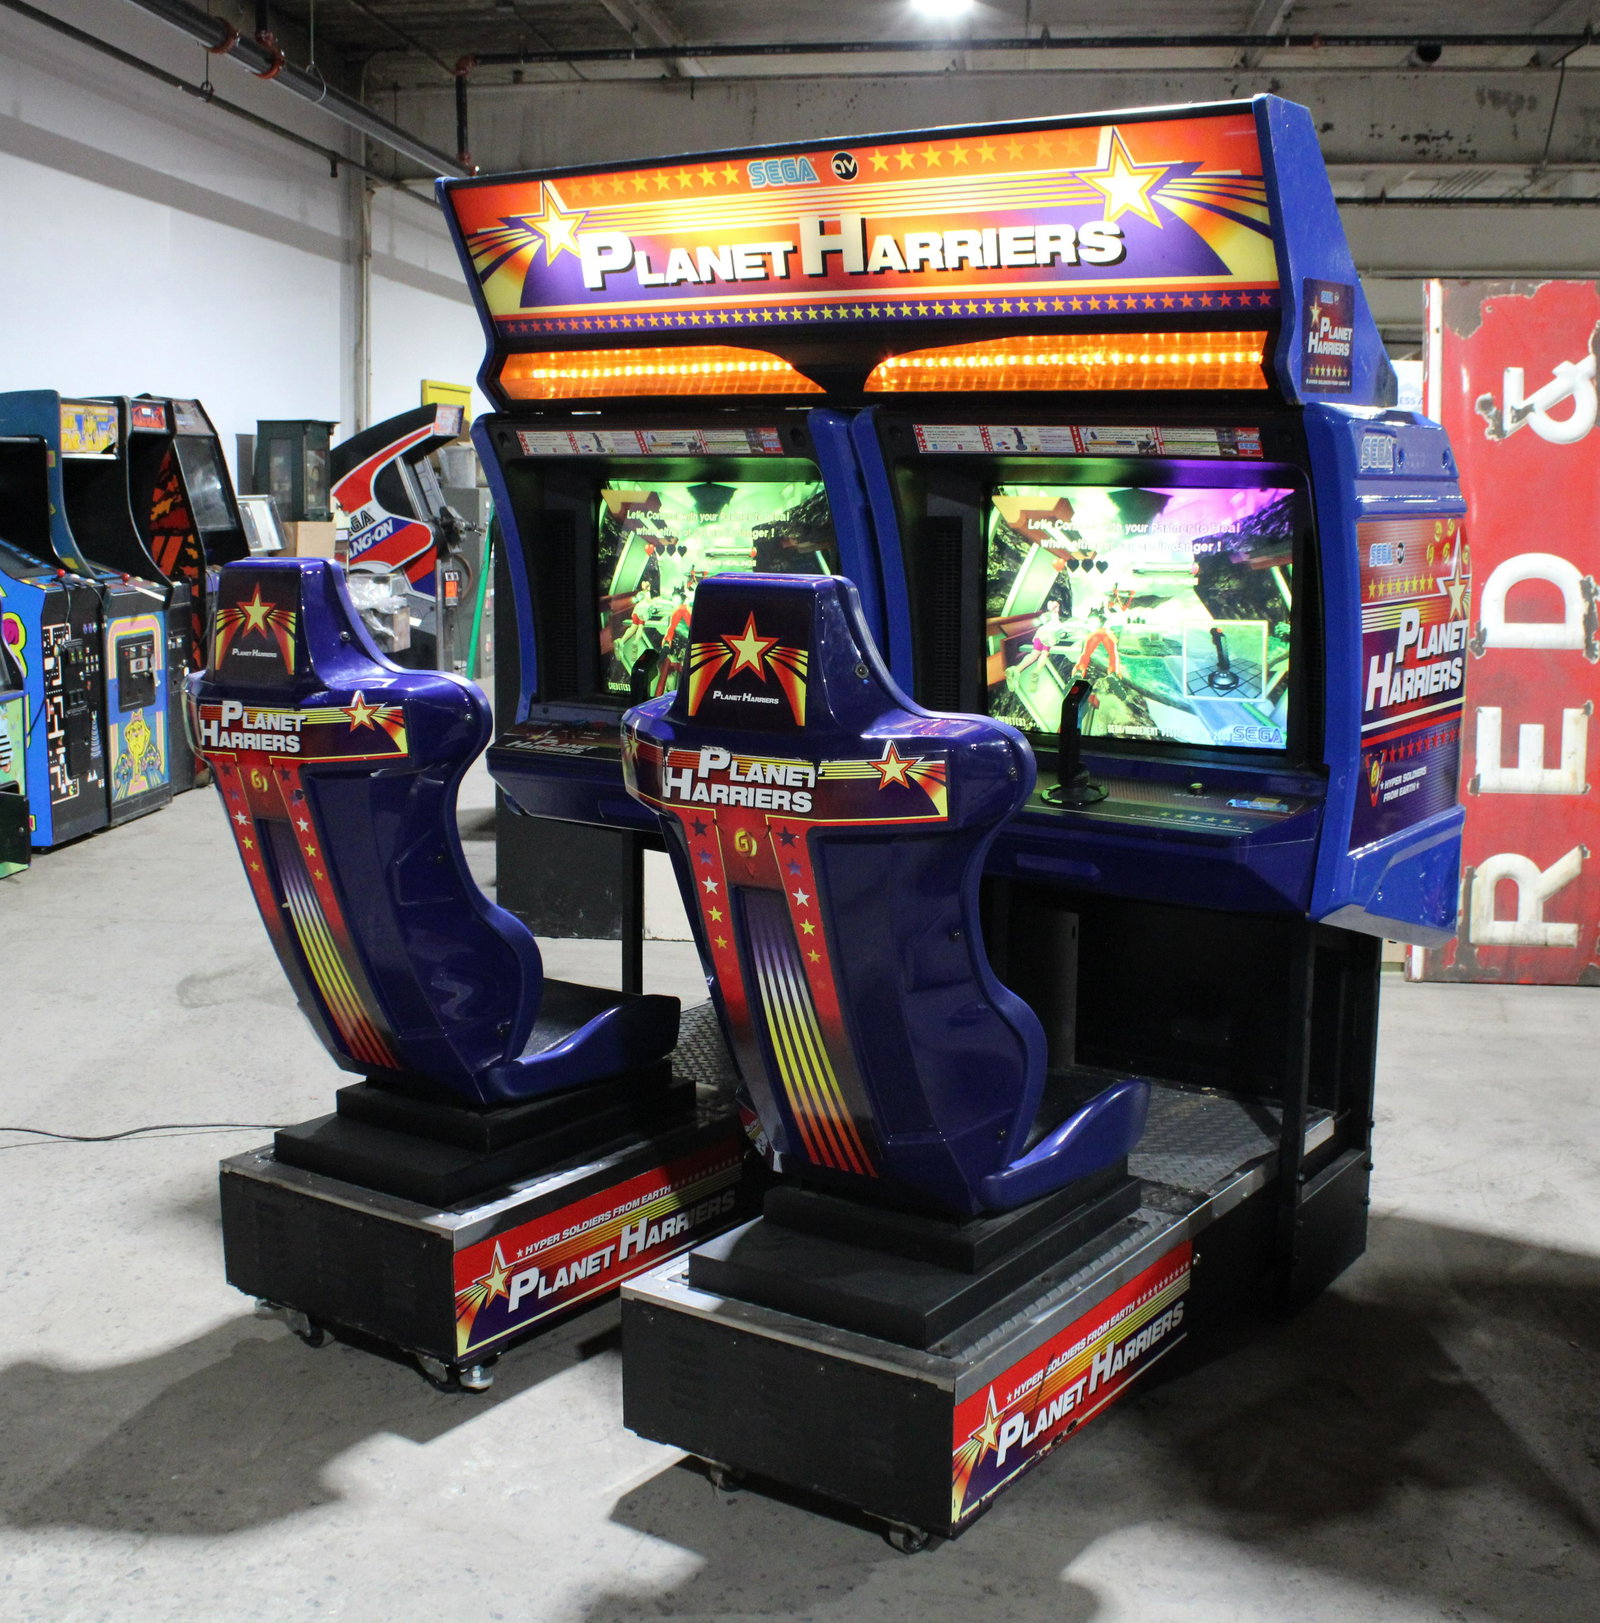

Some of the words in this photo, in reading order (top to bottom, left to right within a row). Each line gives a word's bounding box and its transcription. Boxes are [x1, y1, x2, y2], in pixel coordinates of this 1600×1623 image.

[747, 156, 820, 188] SEGA
[577, 231, 796, 291] PLANET
[799, 212, 1126, 276] HARRIERS
[1308, 331, 1350, 357] HARRIERS
[1320, 317, 1352, 342] PLANET
[1362, 436, 1393, 469] SEGA
[700, 512, 719, 523] your
[1125, 523, 1149, 535] your
[1369, 542, 1393, 567] SEGA
[1396, 608, 1470, 665] PLANET
[713, 690, 742, 701] PLANET
[742, 693, 779, 704] HARRIERS
[1365, 652, 1463, 712] HARRIERS
[222, 701, 306, 732] PLANET
[200, 720, 300, 753] HARRIERS
[1233, 725, 1283, 744] SEGA
[1470, 553, 1589, 947] RED
[697, 745, 818, 788] PLANET
[1384, 773, 1402, 790] HYPER
[663, 767, 812, 813] HARRIERS
[1383, 789, 1399, 803] FROM
[525, 1234, 560, 1255] HYPER
[562, 1211, 612, 1240] SOLDIERS
[613, 1197, 641, 1216] FROM
[641, 1184, 671, 1204] EARTH
[508, 1244, 615, 1313] PLANET
[619, 1188, 737, 1263] HARRIERS
[1014, 1371, 1044, 1399] HYPER
[1044, 1340, 1086, 1379] SOLDIERS
[1087, 1323, 1111, 1346] FROM
[1110, 1301, 1136, 1327] EARTH
[997, 1376, 1088, 1468] PLANET
[1088, 1301, 1184, 1395] HARRIERS
